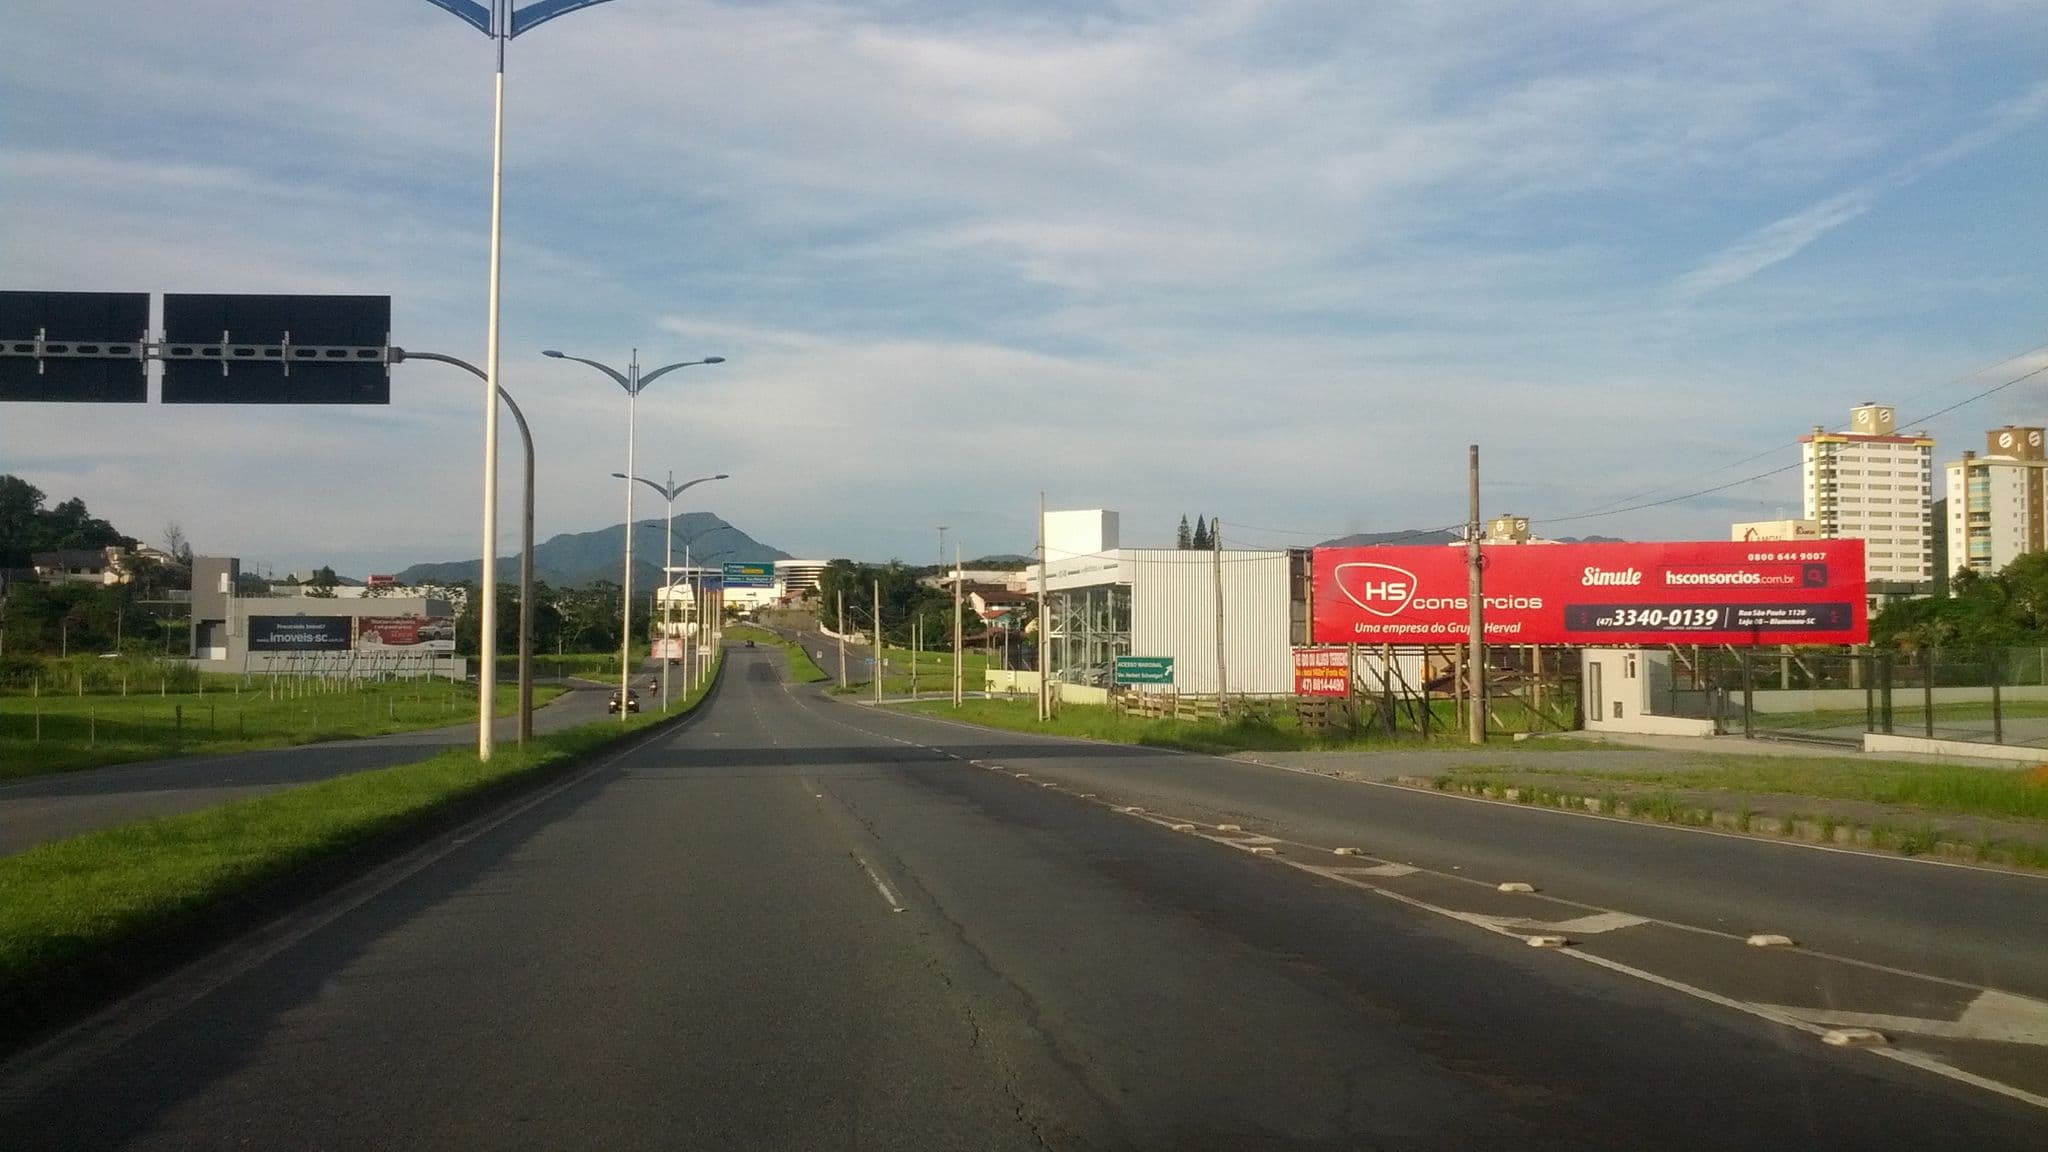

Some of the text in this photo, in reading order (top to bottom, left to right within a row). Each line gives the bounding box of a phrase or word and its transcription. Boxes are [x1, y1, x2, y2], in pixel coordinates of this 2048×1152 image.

[1747, 552, 1827, 561] 0800 644 9007
[1581, 567, 1643, 587] Simule
[1666, 570, 1795, 586] hsconsorcios.com.br
[1365, 581, 1407, 601] HS
[1412, 594, 1543, 610] consrcios
[1613, 609, 1719, 627] 3340-0139
[1355, 622, 1521, 636] Uma empresa do Gru Herval
